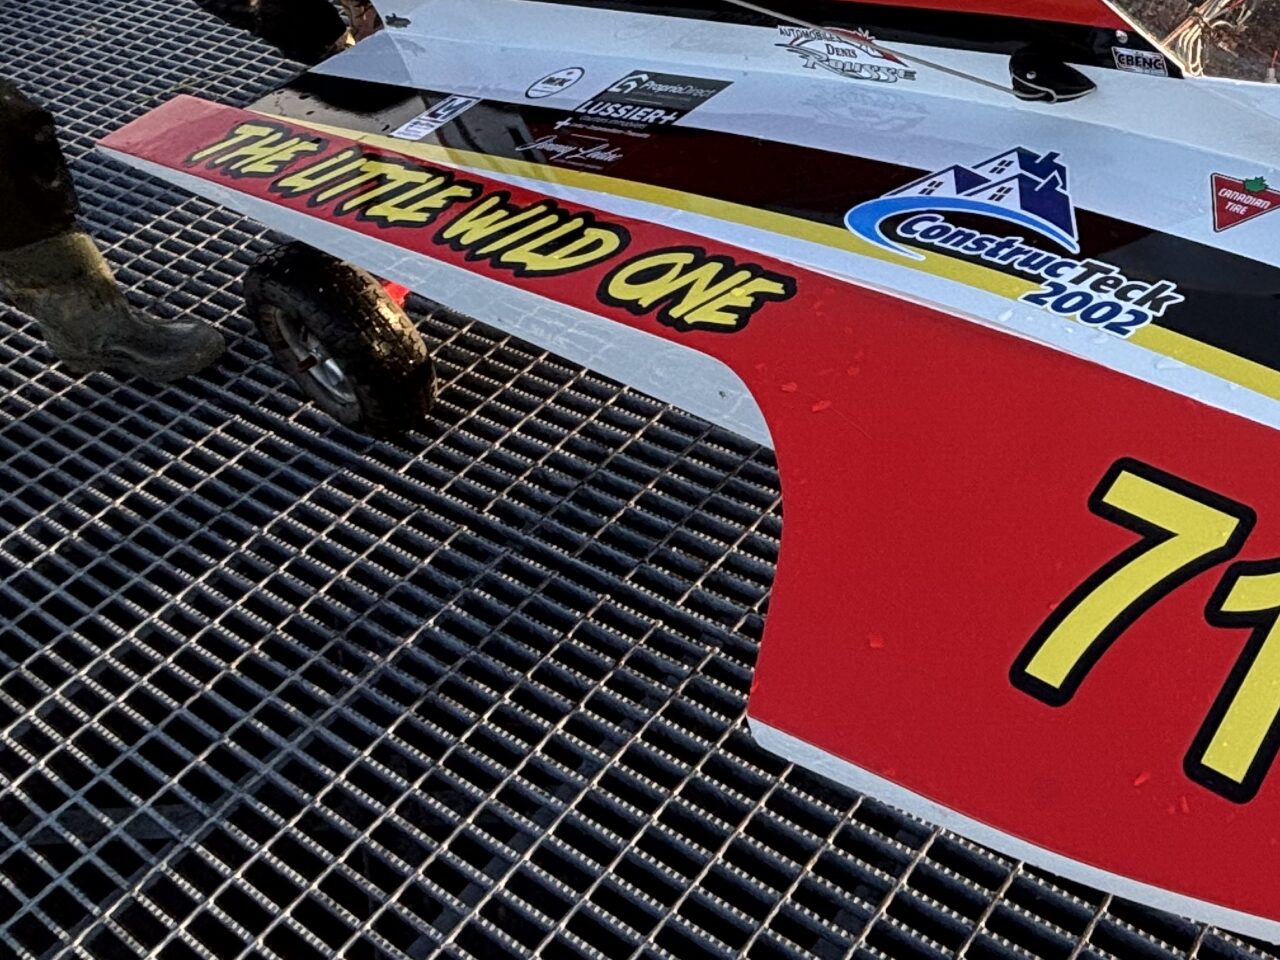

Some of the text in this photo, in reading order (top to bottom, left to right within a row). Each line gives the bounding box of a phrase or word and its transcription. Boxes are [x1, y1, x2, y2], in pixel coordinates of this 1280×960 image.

[190, 121, 793, 330] THE LITTLE WILD ONE
[1218, 188, 1271, 210] CANADIAN
[1225, 201, 1248, 215] TIRE
[896, 210, 1184, 316] ConstrucTeck
[1018, 279, 1155, 337] 2002
